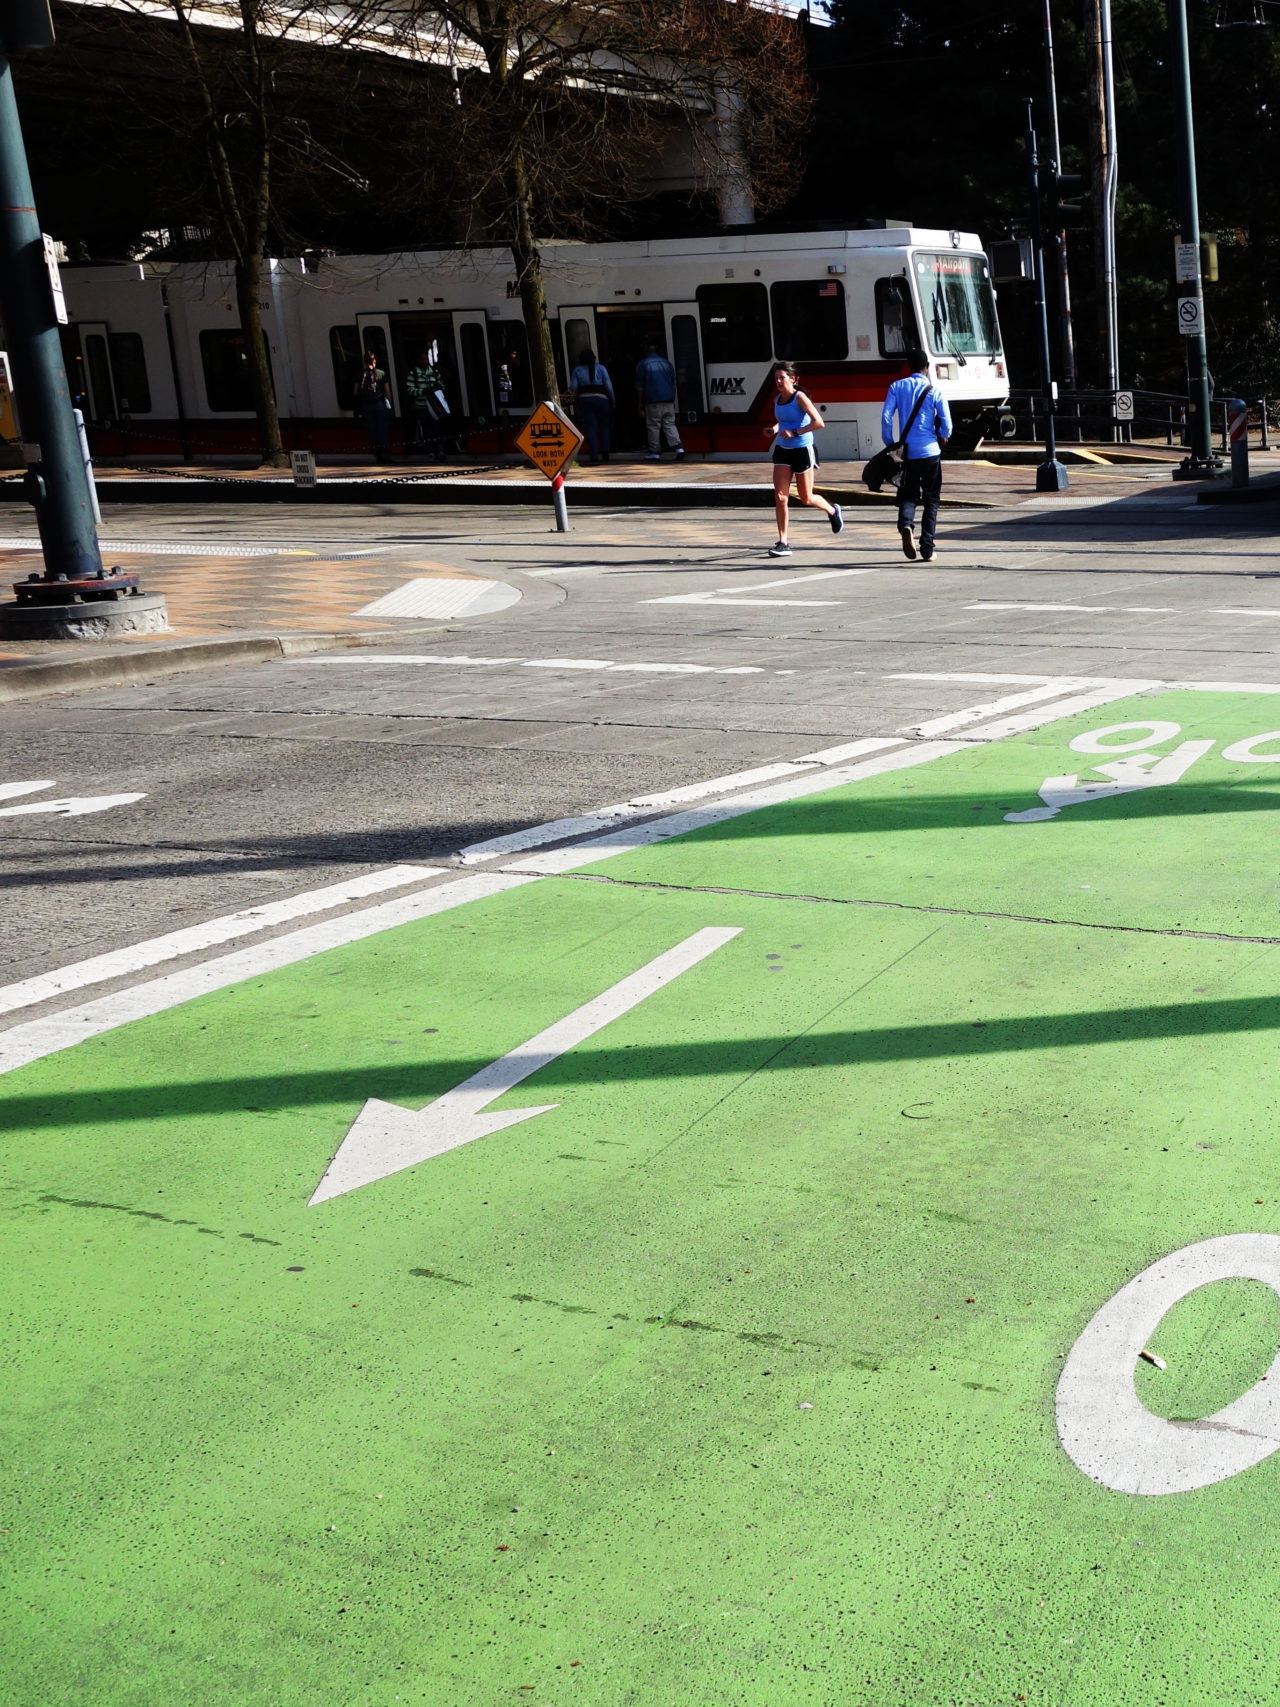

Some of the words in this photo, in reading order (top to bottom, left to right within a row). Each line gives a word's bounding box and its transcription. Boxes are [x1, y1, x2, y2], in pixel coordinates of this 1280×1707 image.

[942, 257, 969, 272] Airport
[709, 377, 745, 393] MAX
[550, 450, 565, 458] BOTH
